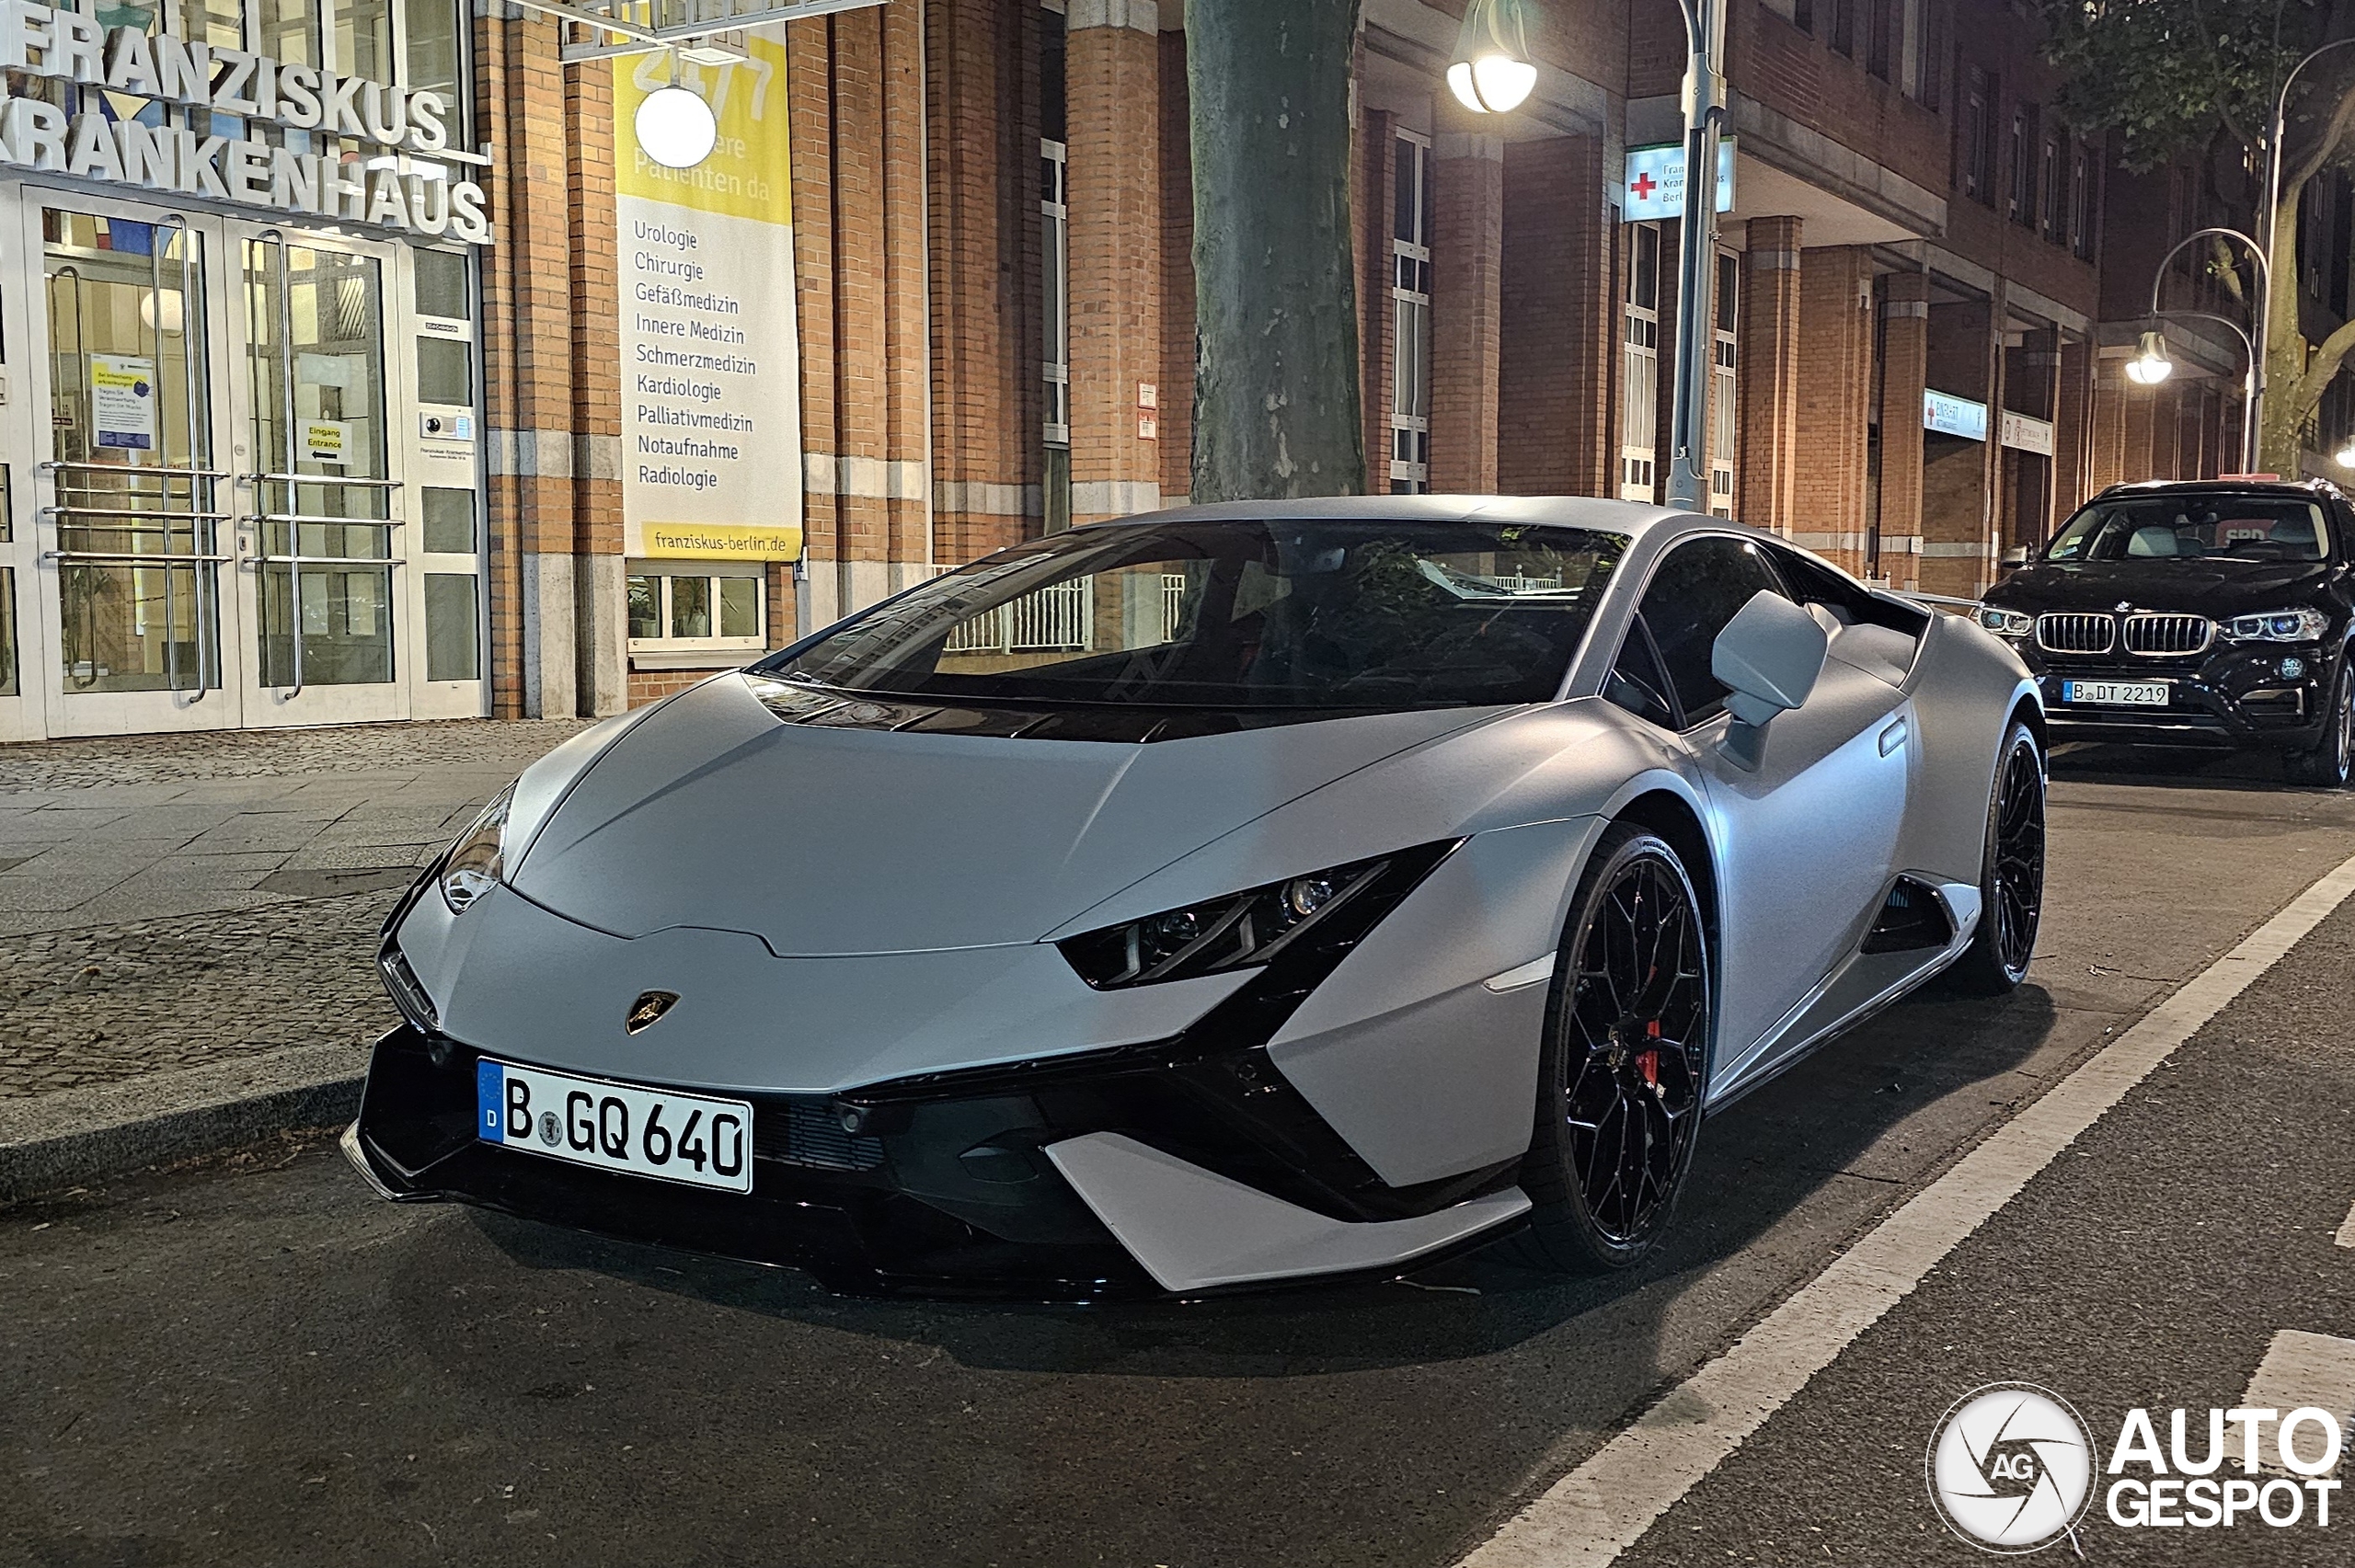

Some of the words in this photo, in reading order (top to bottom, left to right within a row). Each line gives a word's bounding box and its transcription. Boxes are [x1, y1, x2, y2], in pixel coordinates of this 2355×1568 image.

[0, 0, 448, 152] FRANZISKUS
[0, 95, 488, 243] RANKENHAUS
[747, 173, 770, 201] da
[634, 220, 697, 251] Urologie
[635, 252, 704, 280] Chirurgie
[636, 282, 739, 315] Gefäßmedizin
[636, 314, 685, 338] Innere
[689, 321, 745, 345] Medizin
[637, 344, 756, 375] Schmerzmedizin
[637, 375, 722, 404] Kardiologie
[309, 427, 340, 438] Eingang
[638, 406, 753, 432] Palliativmedizin
[307, 439, 342, 449] Entrance
[638, 435, 739, 461] Notaufnahme
[638, 465, 718, 491] Radiologie
[655, 532, 787, 554] franziskus-berlin.de
[2074, 684, 2084, 699] B
[2096, 685, 2118, 701] DT
[2123, 686, 2166, 702] 2219
[486, 1110, 497, 1128] D
[505, 1077, 534, 1140] B
[566, 1090, 630, 1162] GQ
[642, 1103, 744, 1178] 640
